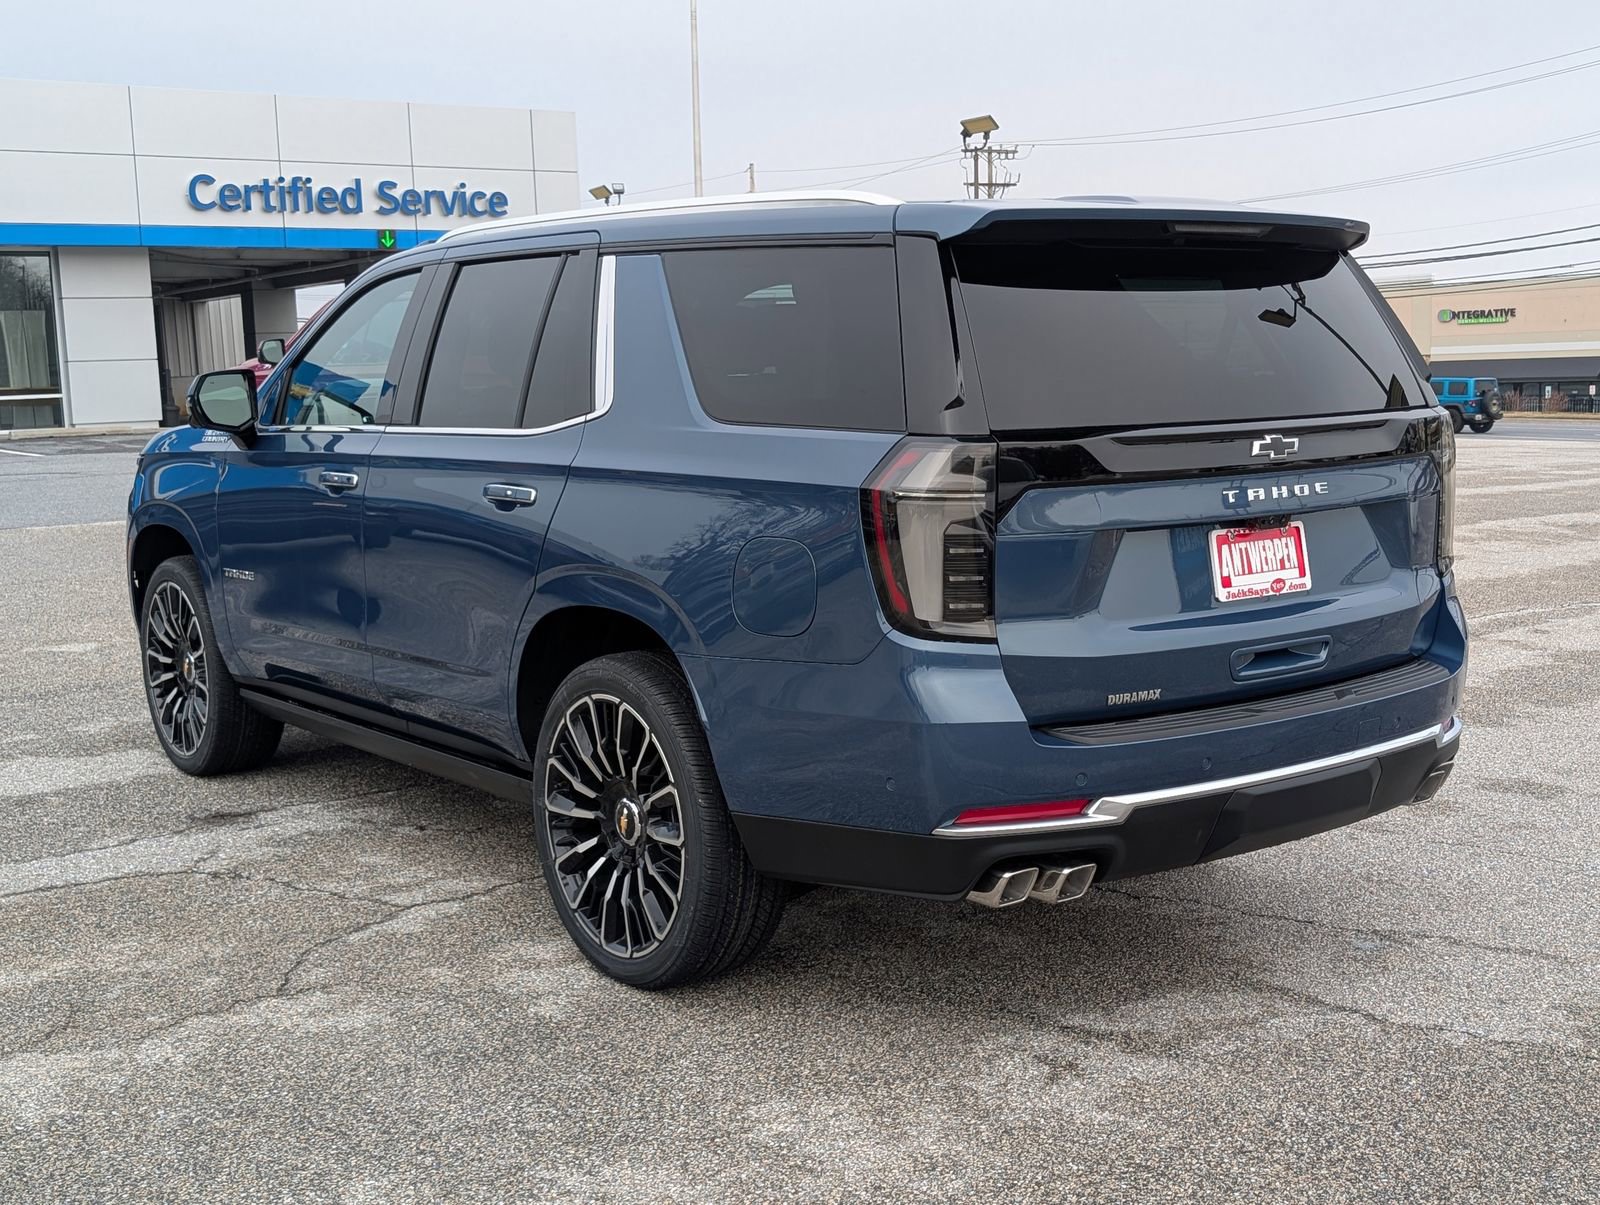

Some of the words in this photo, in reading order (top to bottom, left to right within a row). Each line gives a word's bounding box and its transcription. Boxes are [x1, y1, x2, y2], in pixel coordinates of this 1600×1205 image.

[188, 174, 363, 214] Certified
[377, 181, 508, 217] Service
[1222, 481, 1329, 503] TAHOE
[1221, 536, 1299, 577] ANTWERPEN
[1107, 688, 1162, 706] DURAMAX
